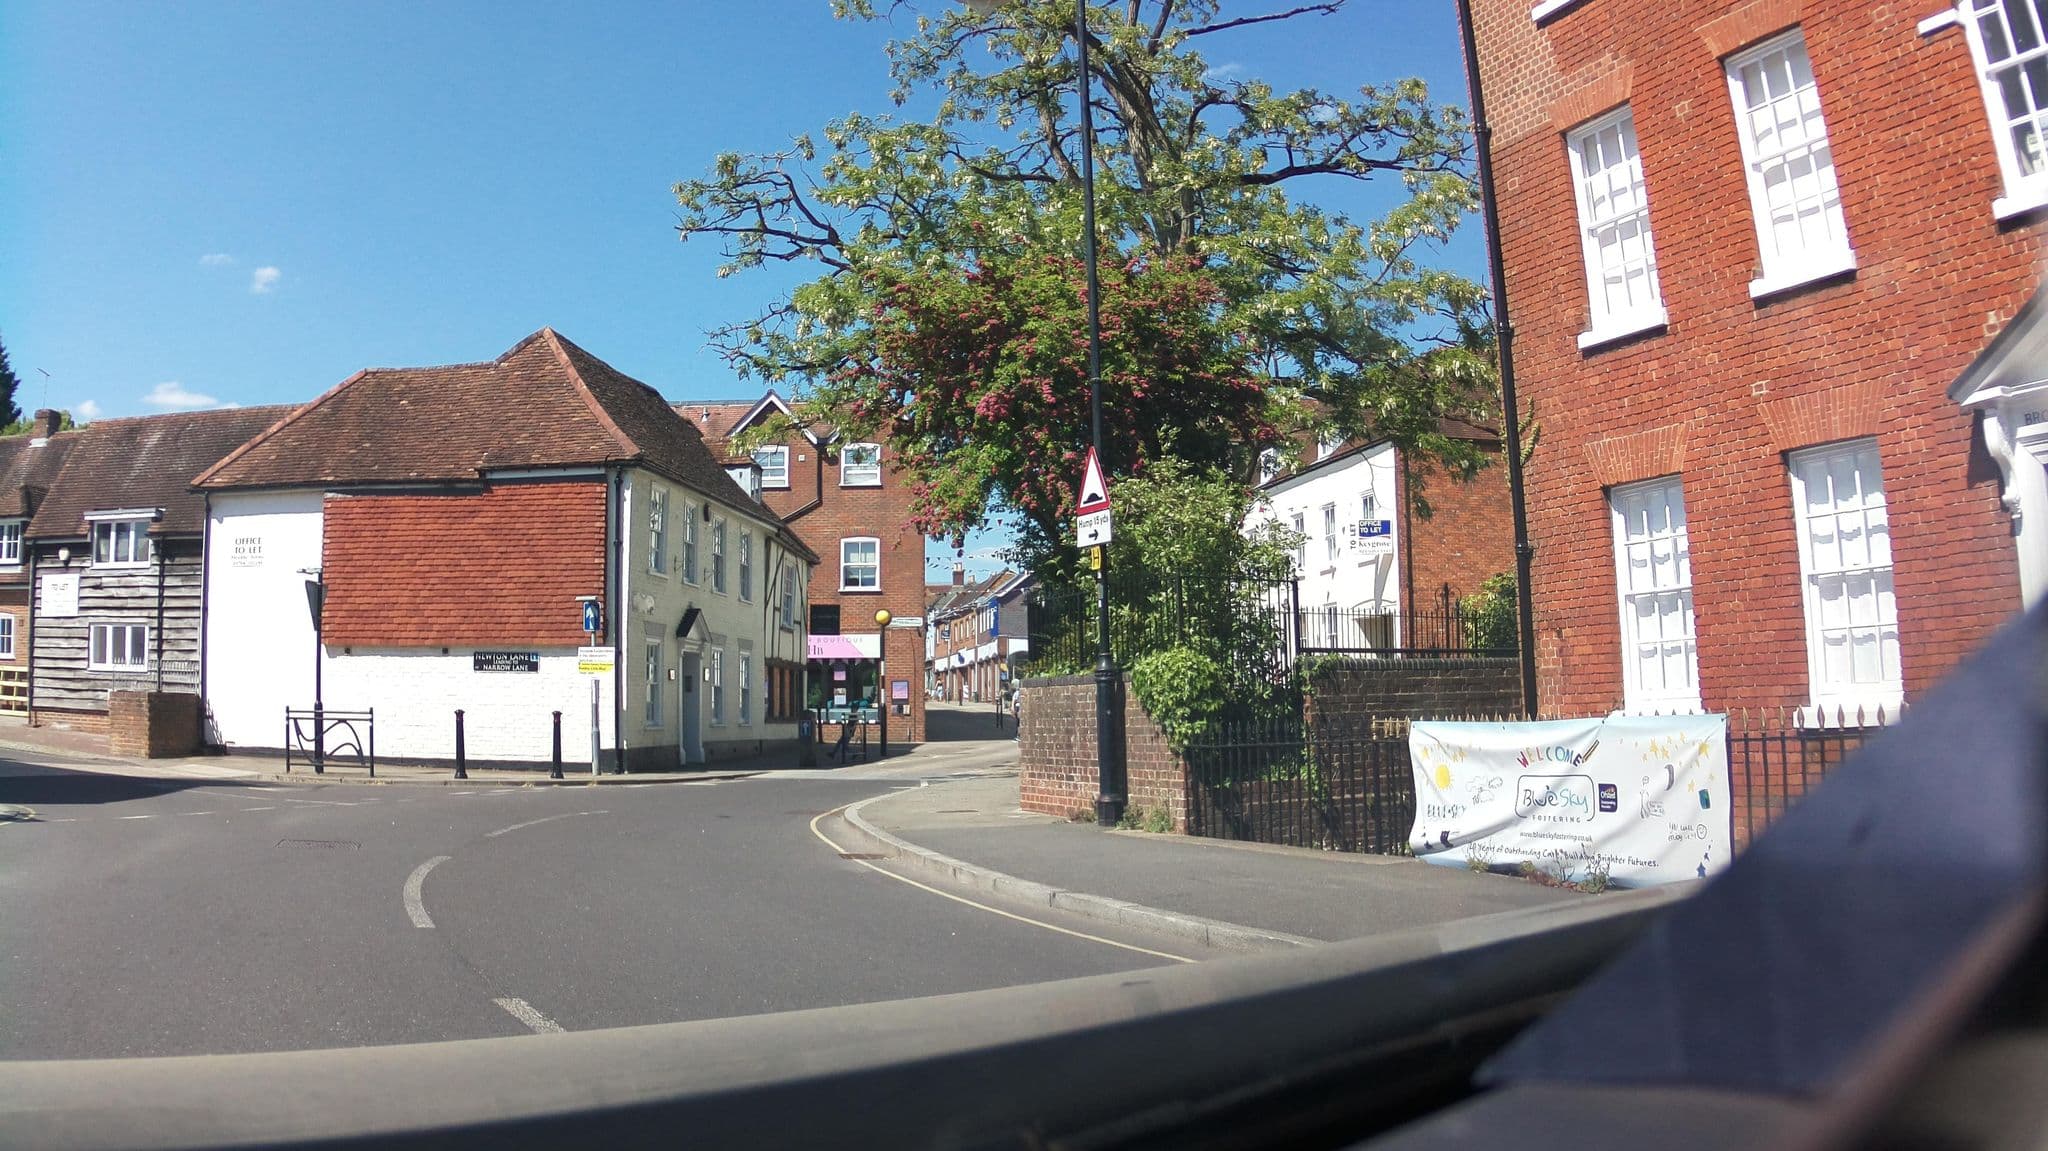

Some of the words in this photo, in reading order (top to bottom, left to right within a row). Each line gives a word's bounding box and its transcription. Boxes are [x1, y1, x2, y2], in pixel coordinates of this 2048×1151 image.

[1079, 520, 1093, 528] Hump
[235, 537, 262, 545] OFFICE
[1350, 540, 1356, 549] TO
[235, 546, 246, 554] TO
[249, 546, 262, 554] LET
[1093, 547, 1099, 566] H
[1517, 746, 1582, 768] WELCOME
[1532, 814, 1581, 823] FOSTERING
[1478, 843, 1496, 852] Years
[1504, 847, 1541, 859] Outstanding
[1597, 853, 1625, 865] Brighter
[1627, 855, 1660, 867] Futures.
